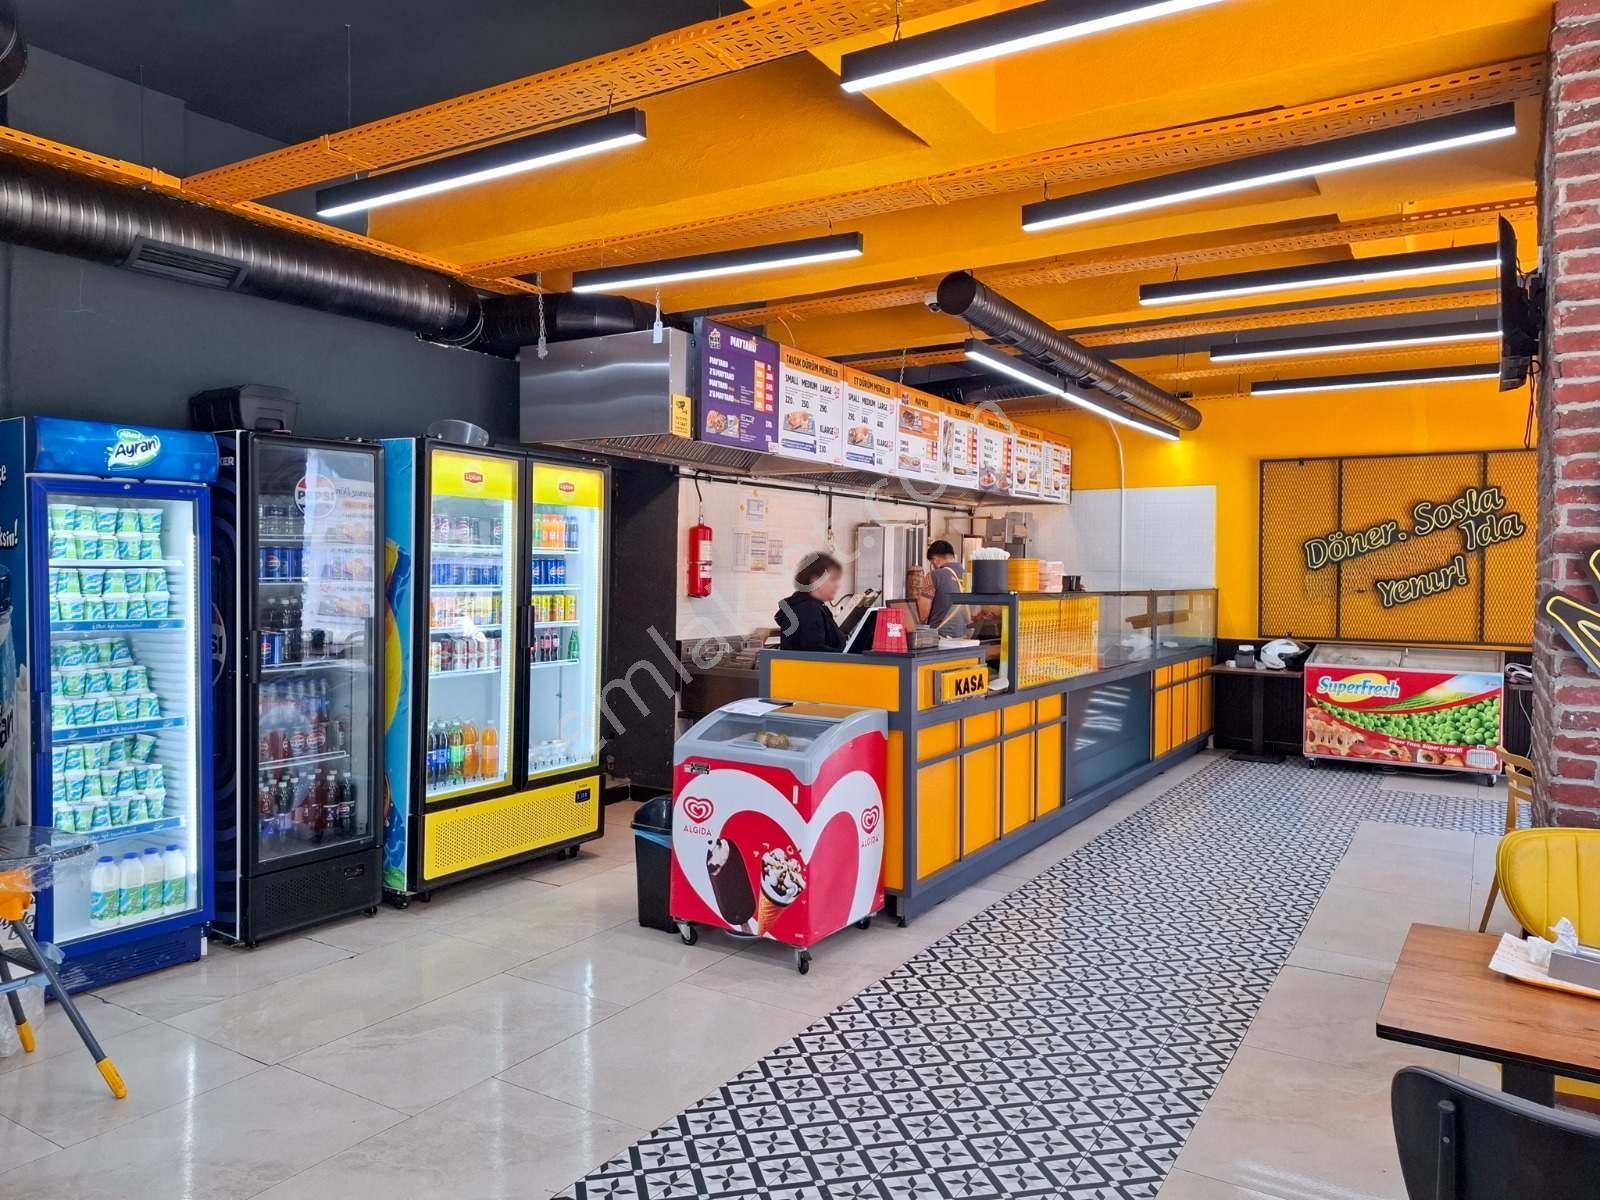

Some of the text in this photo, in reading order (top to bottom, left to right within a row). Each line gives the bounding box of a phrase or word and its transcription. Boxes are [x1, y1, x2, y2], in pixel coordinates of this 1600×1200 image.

[786, 354, 802, 367] TAVUK
[802, 357, 819, 371] DÜRÜM
[785, 374, 799, 385] SMALL
[801, 379, 818, 390] MEDIUM
[820, 384, 832, 394] LARGE
[115, 438, 159, 458] Ayran
[1414, 488, 1504, 536] Sosla
[955, 673, 985, 696] KASA
[1317, 676, 1400, 698] SuperFresh
[683, 825, 713, 837] ALGIDA
